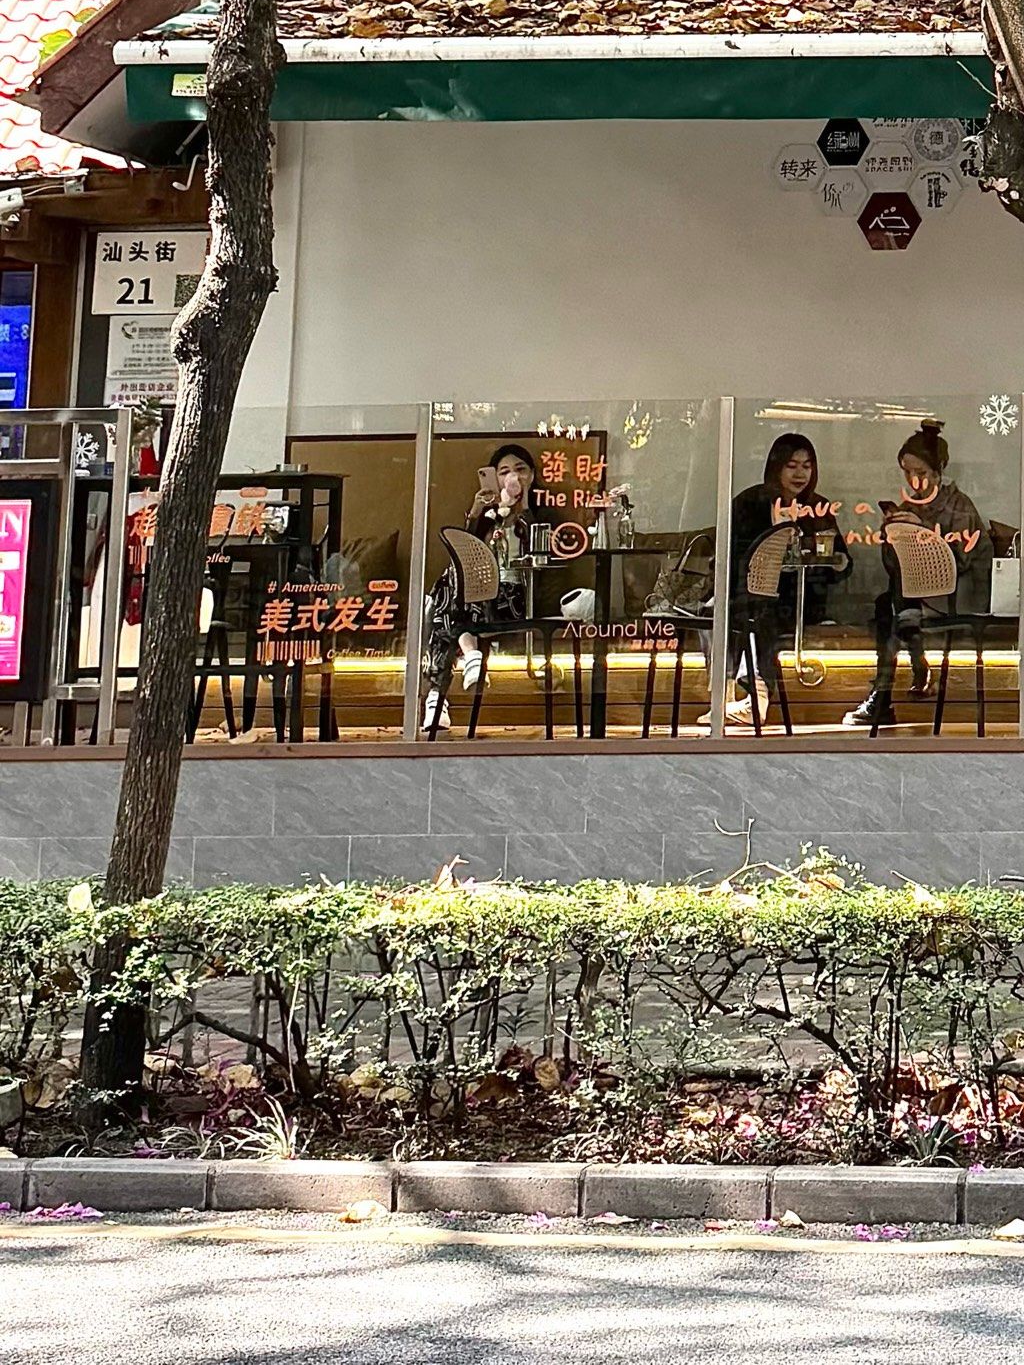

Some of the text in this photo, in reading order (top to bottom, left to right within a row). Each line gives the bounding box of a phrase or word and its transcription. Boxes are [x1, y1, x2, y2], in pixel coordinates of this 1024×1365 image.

[780, 158, 817, 179] 转来
[102, 240, 176, 263] 汕头街
[116, 277, 154, 305] 21
[541, 450, 609, 483] 發財
[533, 489, 568, 508] The
[772, 497, 876, 525] Have a
[282, 581, 345, 593] Americano
[256, 595, 399, 635] 美式发生
[562, 619, 675, 638] Around Me
